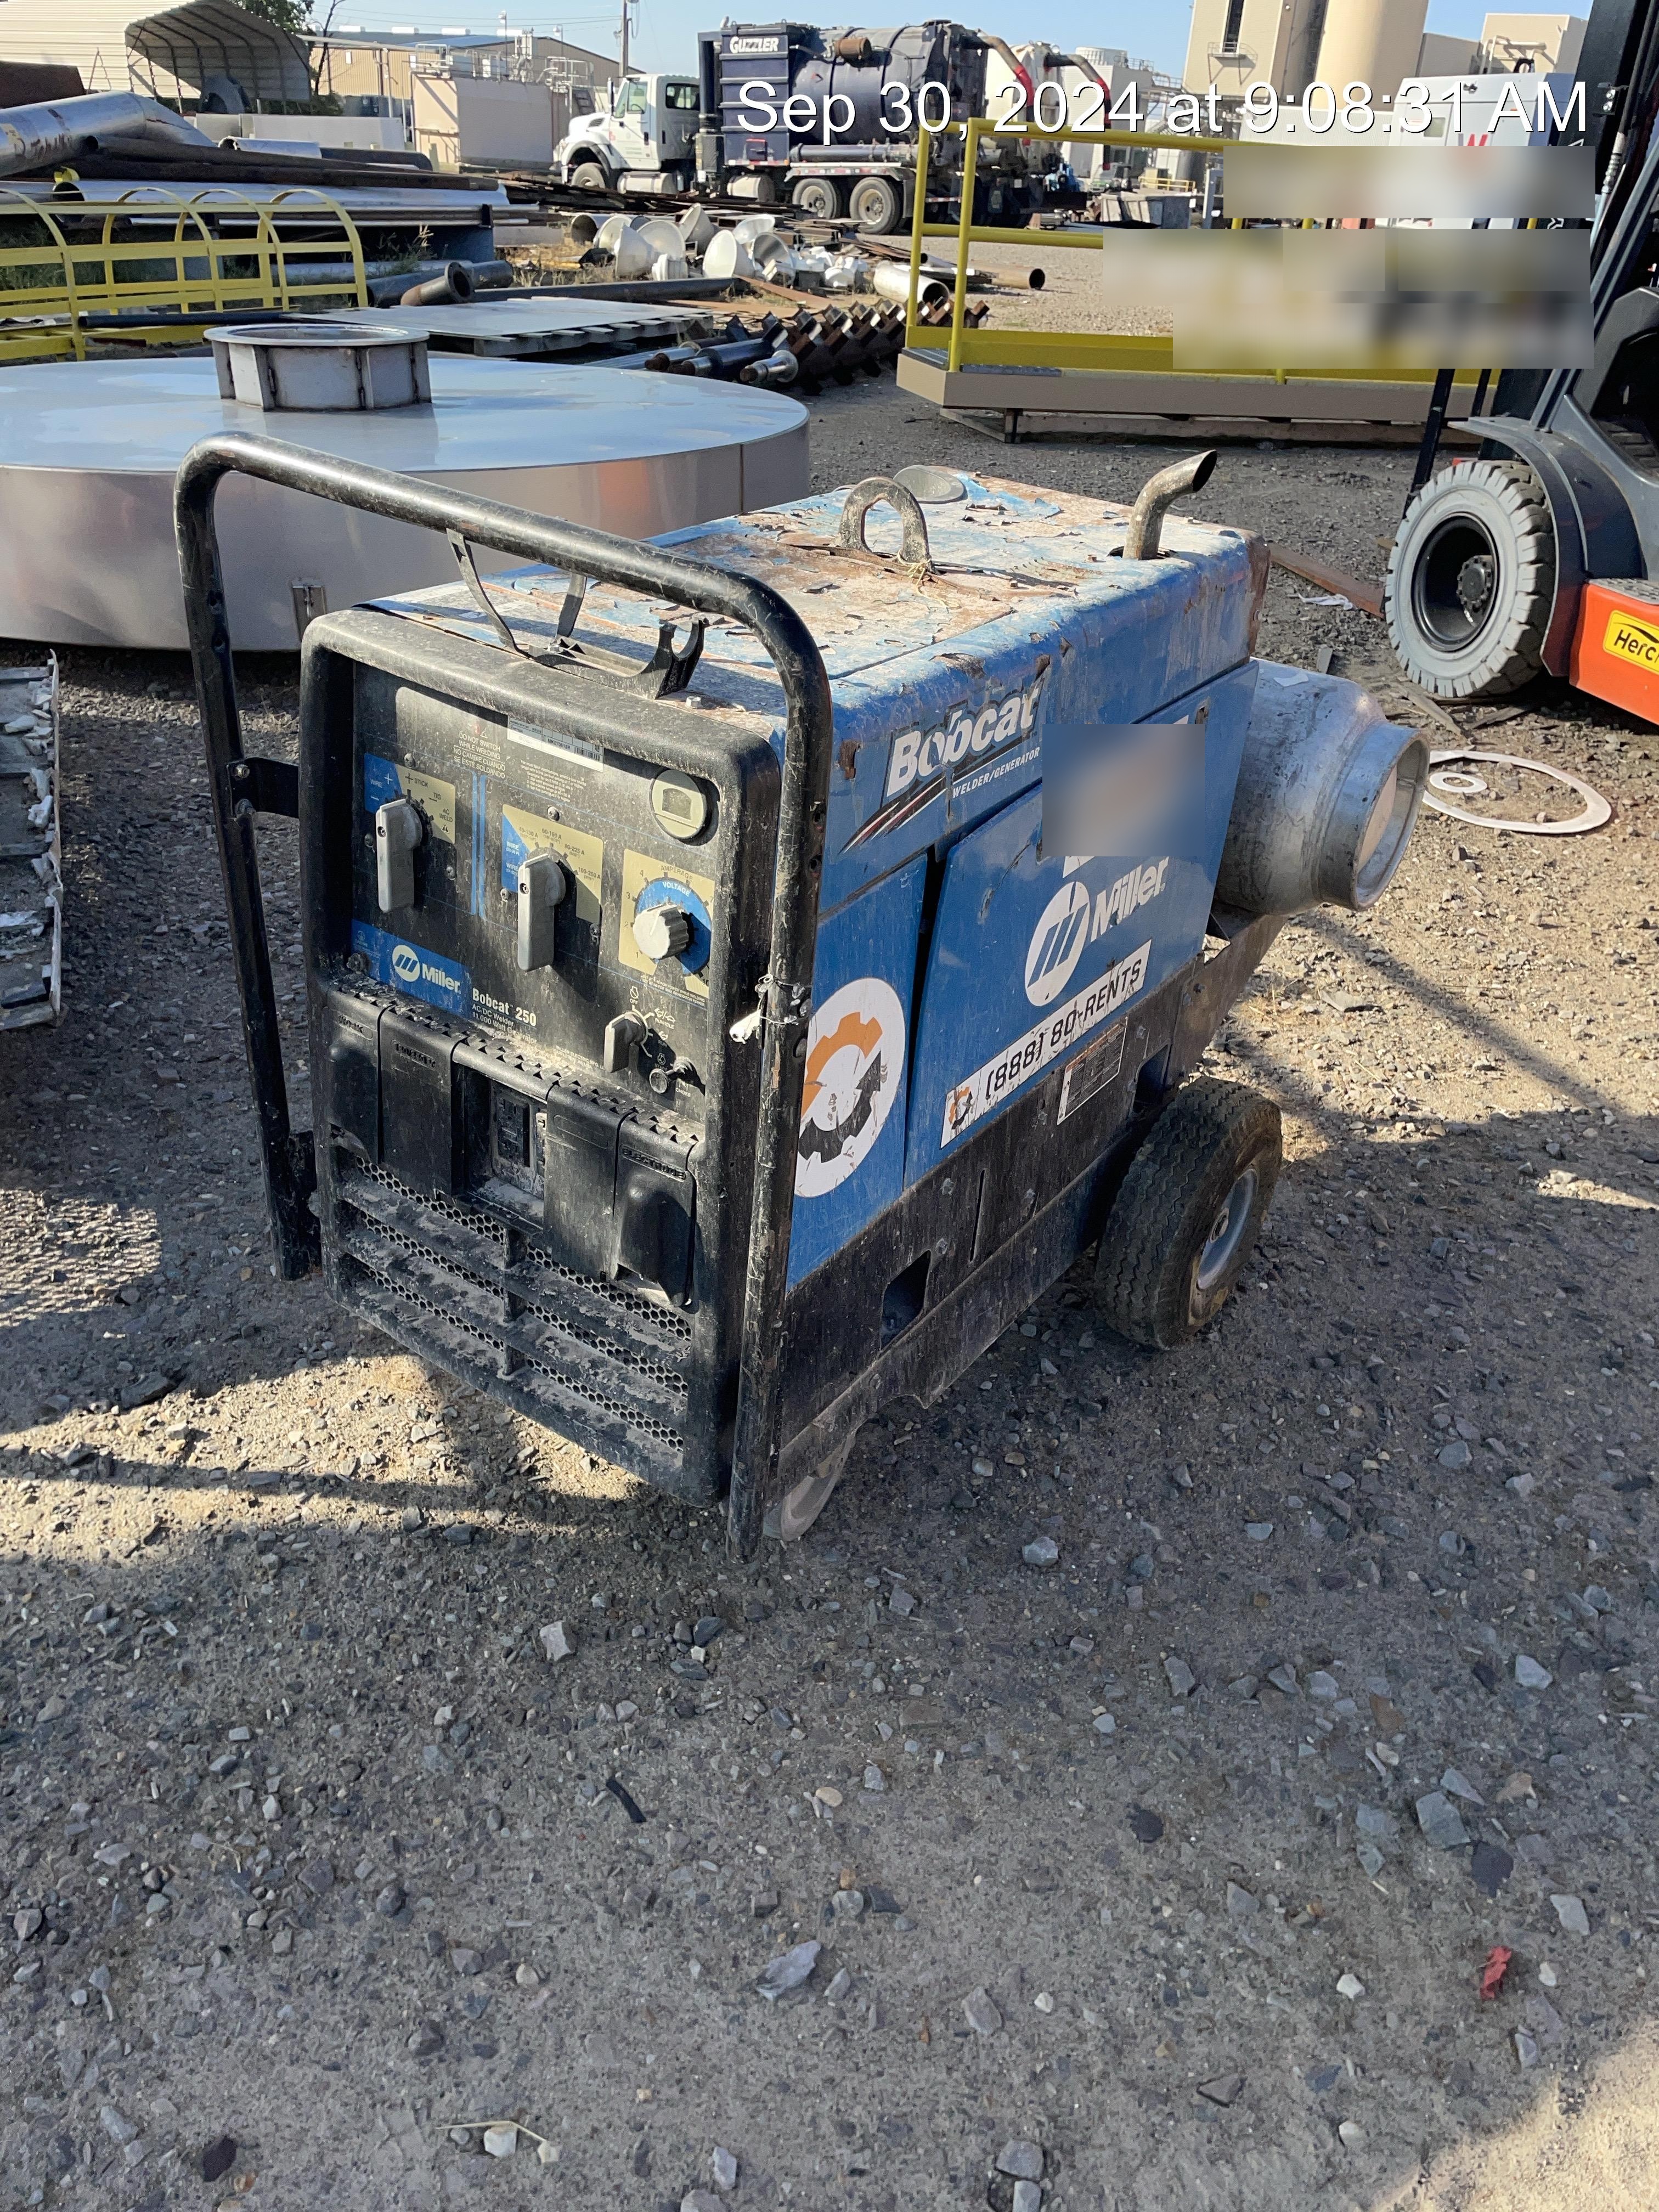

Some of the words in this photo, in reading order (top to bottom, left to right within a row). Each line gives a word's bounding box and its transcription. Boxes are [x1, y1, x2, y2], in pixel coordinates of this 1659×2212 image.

[730, 36, 779, 53] GUZZLER
[459, 740, 475, 751] WHILE
[476, 746, 500, 760] WELDING
[468, 736, 478, 744] NOT
[480, 740, 500, 752] SWITCH
[887, 688, 1039, 797] Bobcat
[462, 758, 475, 768] ESTE
[476, 764, 505, 779] SOLDANDO
[483, 759, 505, 771] CUANDO
[952, 747, 1040, 798] WELDER/GENERATOR
[370, 778, 382, 788] WIRE
[414, 778, 428, 788] STICK
[439, 813, 453, 823] WELD
[506, 841, 519, 850] WIRE
[506, 862, 518, 872] WIRE
[578, 867, 596, 878] 100-250
[661, 866, 692, 882] AMPERAGE
[662, 882, 691, 896] VOLTAGE
[1091, 856, 1169, 943] Miller
[422, 963, 460, 994] Miller
[472, 988, 509, 1015] Bobcat
[515, 1007, 537, 1026] 250
[472, 1004, 492, 1015] AC/DC
[493, 1013, 514, 1026] Welder
[493, 1020, 506, 1031] Watt
[986, 1032, 1045, 1100] (888)
[1051, 958, 1142, 1047] 80-RENTS
[675, 1087, 691, 1098] CHOKE
